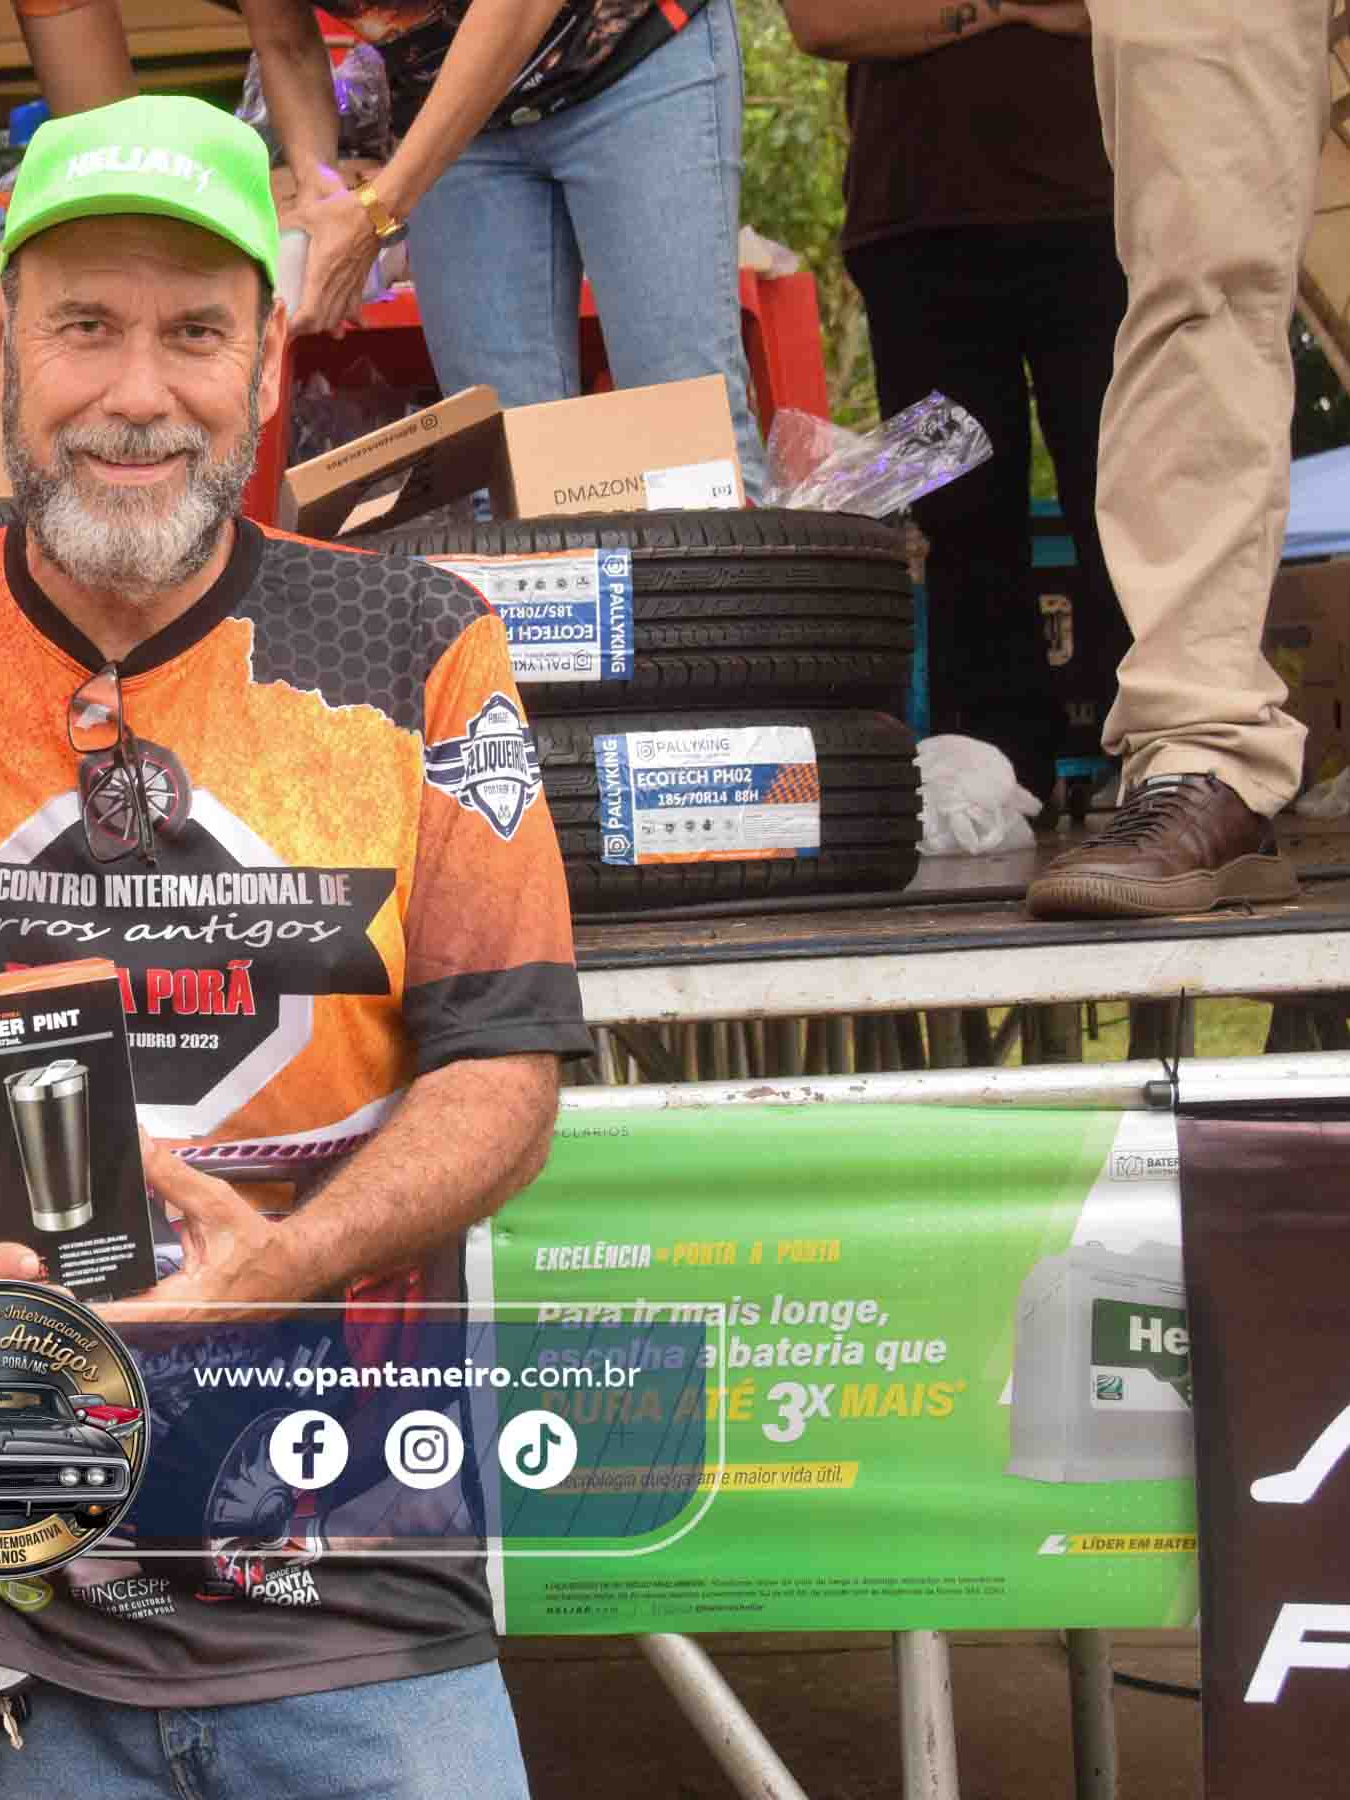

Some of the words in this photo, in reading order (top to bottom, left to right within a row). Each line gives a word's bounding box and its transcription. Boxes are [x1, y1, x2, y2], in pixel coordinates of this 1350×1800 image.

[554, 473, 646, 505] DMAZON
[500, 604, 573, 619] 185/70R14
[518, 624, 594, 641] ECOTECH
[609, 583, 626, 673] PALLYKING
[514, 658, 571, 672] PALLYKI
[656, 737, 731, 753] PALLYKING
[604, 739, 623, 829] PALLYKING
[636, 771, 710, 787] ECOTECH
[713, 768, 752, 784] PH02
[658, 791, 728, 806] 185/70R14
[104, 872, 314, 908] INTERNACIONAL
[318, 872, 353, 906] DE
[124, 911, 342, 948] antigos
[148, 959, 257, 1016] PORÃ
[32, 1008, 81, 1033] PINT
[128, 1032, 177, 1050] TUBRO
[180, 1032, 220, 1050] 2023
[561, 1126, 630, 1138] CLARIOS
[535, 1240, 651, 1271] EXCELÊNCIA
[538, 1301, 621, 1328] Para
[633, 1297, 658, 1328] ir
[670, 1296, 761, 1328] mais
[769, 1295, 890, 1330] longe,
[538, 1337, 684, 1369] escolha
[696, 1343, 717, 1368] a
[728, 1335, 865, 1369] bateria
[874, 1337, 948, 1371] que
[542, 1389, 664, 1424] DURA
[672, 1377, 758, 1424] ATÉ
[670, 1470, 730, 1489] garane
[733, 1468, 777, 1486] maior
[780, 1467, 812, 1484] vida
[815, 1464, 844, 1484] útil.
[1081, 1536, 1125, 1551] LÍDER
[1129, 1537, 1151, 1551] EM
[1153, 1537, 1196, 1550] BATE
[252, 1570, 315, 1598] PONTA
